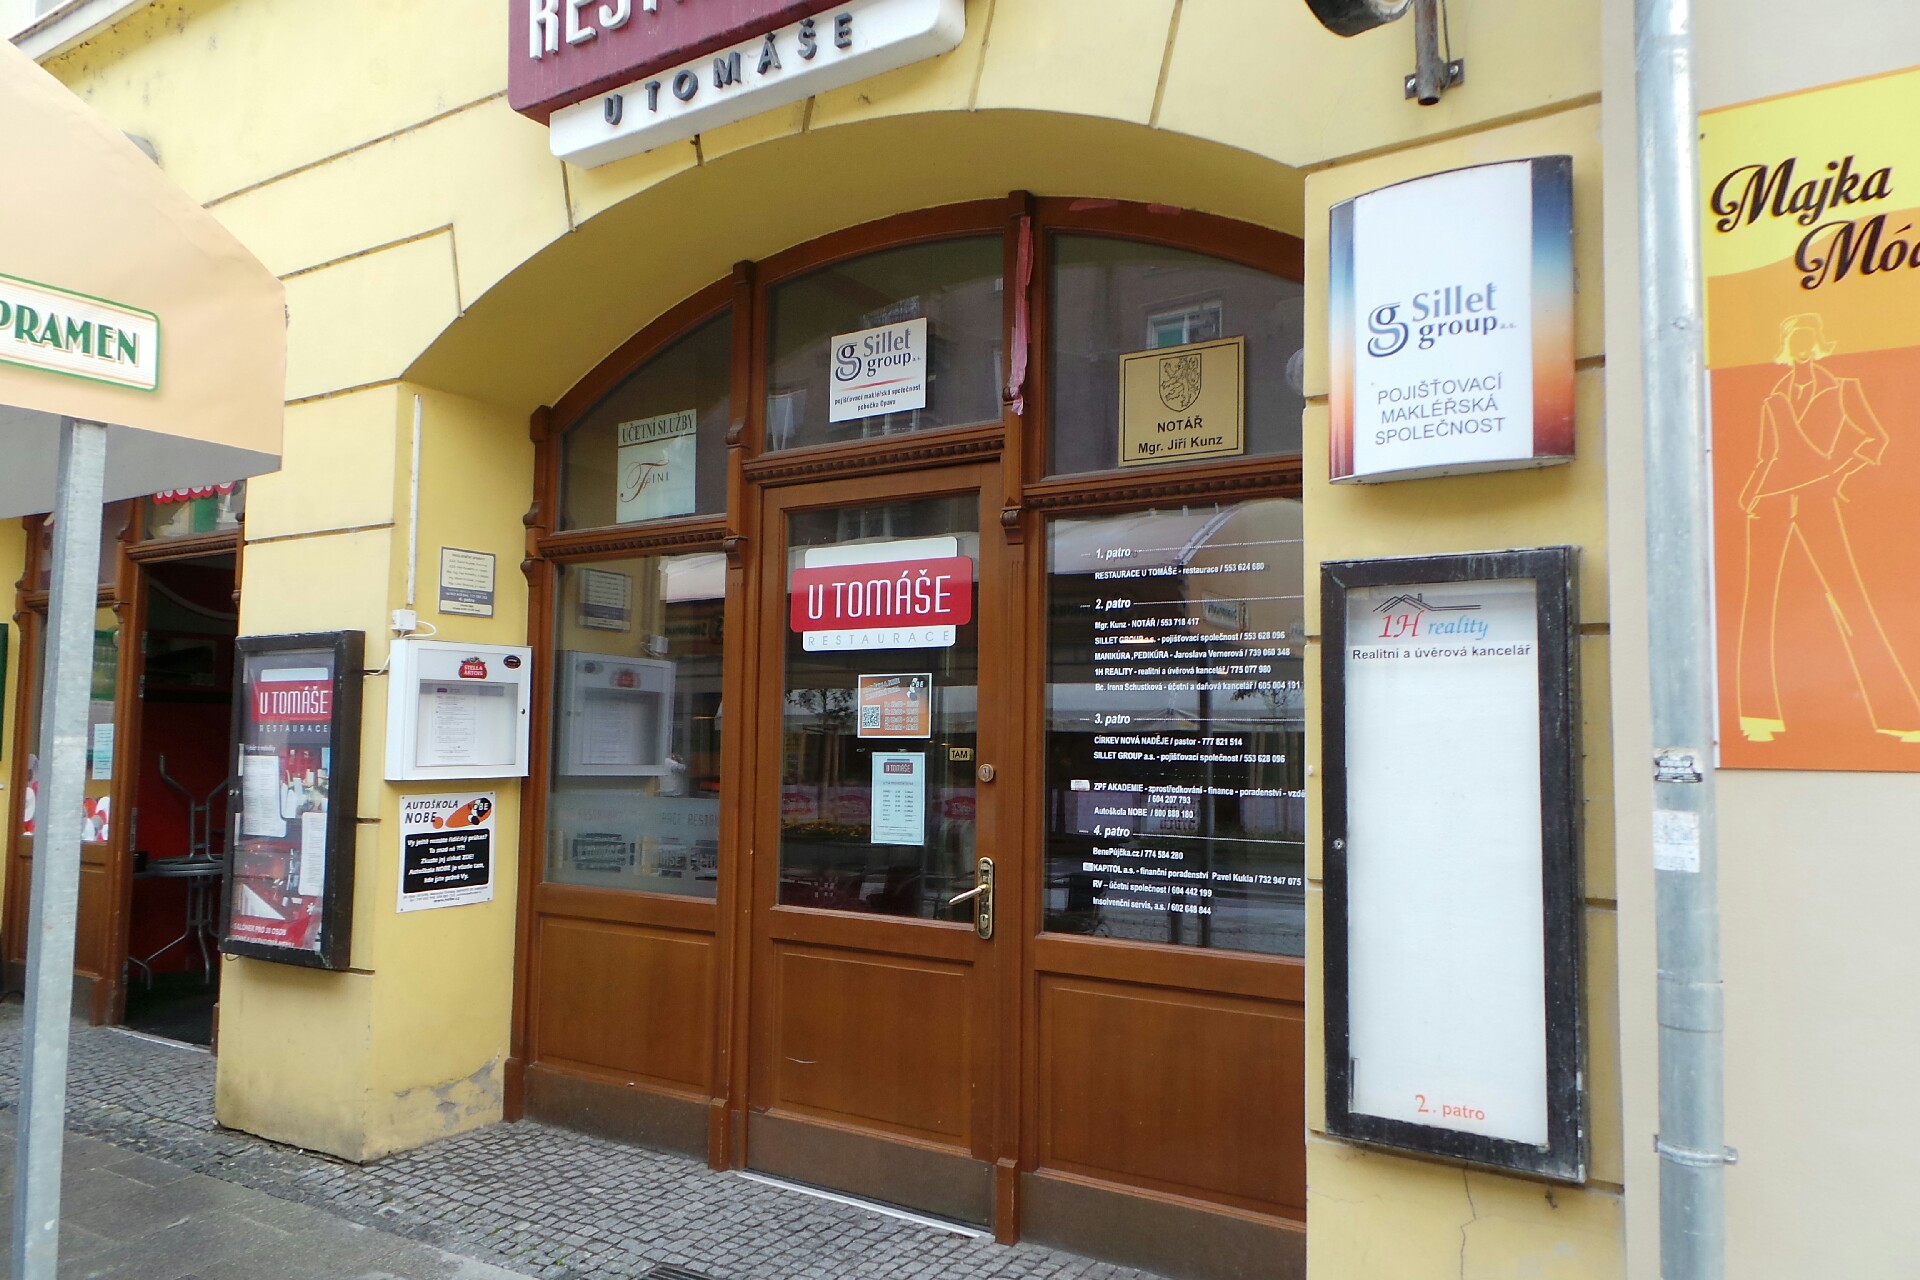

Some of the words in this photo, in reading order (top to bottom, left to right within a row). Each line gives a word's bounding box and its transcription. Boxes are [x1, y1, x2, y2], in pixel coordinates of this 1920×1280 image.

[529, 0, 657, 60] RE
[604, 94, 623, 126] U
[644, 12, 853, 112] TOMÁŠE
[1710, 154, 1894, 233] Majka
[1412, 281, 1497, 322] Sillet
[1418, 314, 1498, 350] group
[864, 328, 911, 357] Sillet
[867, 352, 911, 377] group
[1378, 372, 1503, 405] POJIŠŤOVACÍ
[1381, 393, 1498, 424] MAKLÉŘSKÁ
[622, 417, 656, 443] ÚČETNÍ
[658, 413, 694, 435] SLUŽBY
[1157, 415, 1203, 433] NOTÁŘ
[1375, 417, 1506, 445] SPOLEČNOST
[1138, 443, 1163, 455] Mgr.
[1168, 438, 1186, 450] Jiří
[1191, 436, 1223, 448] Kunz
[1096, 548, 1104, 559] 1.
[1106, 547, 1131, 560] patro
[1095, 569, 1140, 580] RESTAURACE
[1141, 569, 1147, 577] U
[1148, 566, 1177, 576] TOMÁŠE
[1183, 566, 1219, 574] restaurace
[1224, 564, 1237, 572] 553
[808, 584, 823, 620] U
[832, 569, 951, 618] TOMÁŠE
[1095, 599, 1104, 610] 2.
[1105, 598, 1131, 611] patro
[1094, 621, 1109, 630] Mgr.
[1110, 621, 1127, 629] Kunz
[1131, 617, 1155, 628] NOTÁŘ
[1174, 618, 1186, 626] 718
[1378, 609, 1425, 639] 1H
[1428, 614, 1489, 641] reality
[808, 630, 950, 647] RESTAURACE
[1095, 636, 1118, 645] SILLET
[1161, 634, 1199, 644] pojišťovací
[1200, 632, 1239, 643] společnost
[1243, 632, 1256, 640] 553
[1094, 650, 1130, 661] MANIKÚRA
[1173, 650, 1207, 659] Jaroslava
[1208, 648, 1243, 658] Vernerová
[1248, 648, 1261, 657] 739
[1277, 648, 1290, 656] 348
[1352, 648, 1399, 660] Realitní
[1403, 650, 1411, 659] a
[1414, 647, 1467, 659] úvěrová
[1472, 644, 1531, 657] kancelář
[1094, 668, 1104, 676] 1H
[1138, 667, 1160, 675] realitní
[1167, 666, 1195, 675] úvěrová
[1230, 665, 1243, 674] 775
[1244, 665, 1257, 673] 077
[1095, 683, 1106, 691] Bc.
[1107, 683, 1124, 691] Irena
[1124, 682, 1162, 691] Schustková
[1168, 682, 1188, 691] účetní
[1196, 681, 1221, 690] daňová
[1223, 681, 1253, 690] kancelář
[1287, 681, 1300, 689] 191
[260, 692, 268, 714] U
[272, 686, 328, 714] TOMÁŠE
[1094, 713, 1103, 724] 3.
[1104, 713, 1130, 726] patro
[259, 724, 328, 733] RESTAURACE
[1094, 735, 1120, 745] CÍRKEV
[1120, 735, 1140, 745] NOVÁ
[1141, 735, 1169, 745] NADĚJE
[1174, 737, 1197, 746] pastor
[1215, 738, 1228, 746] 821
[1229, 738, 1243, 746] 514
[951, 750, 968, 760] TAM
[1093, 751, 1117, 760] SILLET
[1118, 752, 1143, 760] GROUP
[1160, 753, 1199, 762] pojišťovací
[1200, 753, 1238, 763] společnost
[1243, 754, 1257, 762] 553
[1258, 754, 1271, 763] 628
[1093, 782, 1106, 791] ZPF
[1107, 783, 1144, 792] AKADEMIE
[1148, 785, 1203, 795] zprostředkování
[1208, 786, 1234, 795] finance
[1240, 788, 1282, 797] poradenství
[405, 800, 458, 810] AUTOŠKOLA
[1178, 796, 1191, 804] 793
[405, 812, 437, 824] NOBE
[1094, 806, 1126, 816] Autoškola
[1128, 808, 1148, 817] NOBE
[1093, 824, 1102, 835] 4.
[1104, 826, 1130, 838] patro
[1144, 850, 1156, 858] 774
[1093, 863, 1123, 873] KAPITOL
[1140, 867, 1167, 876] finanční
[1168, 869, 1208, 879] poradenství
[1212, 872, 1231, 881] Pavel
[1233, 874, 1253, 883] Kukla
[1259, 875, 1272, 884] 732
[1272, 876, 1286, 885] 947
[1288, 877, 1302, 886] 075
[1092, 880, 1103, 888] RV
[1109, 881, 1129, 890] účetní
[1130, 884, 1166, 894] společnost
[1171, 886, 1184, 895] 604
[1185, 888, 1198, 896] 442
[1199, 889, 1212, 897] 199
[1092, 896, 1130, 907] Insolvenční
[1171, 903, 1184, 912] 602
[1415, 1094, 1436, 1113] 2.
[1442, 1103, 1485, 1121] patro
